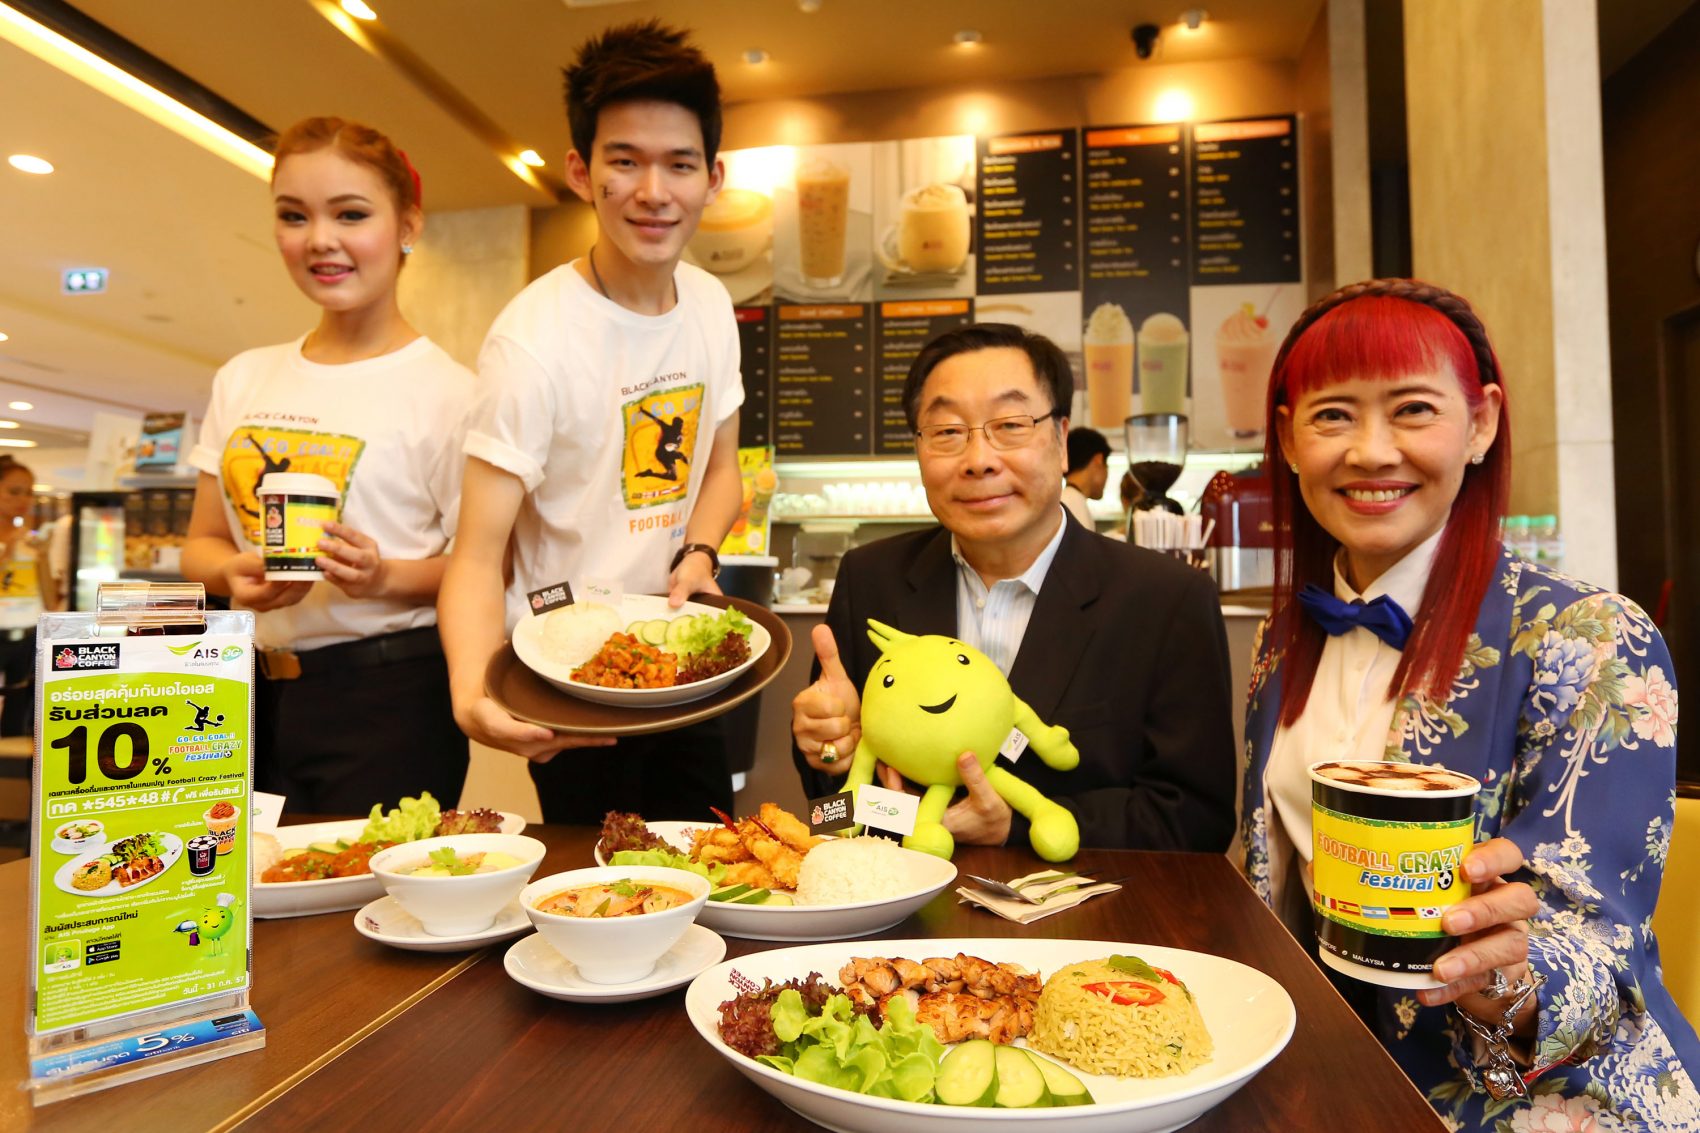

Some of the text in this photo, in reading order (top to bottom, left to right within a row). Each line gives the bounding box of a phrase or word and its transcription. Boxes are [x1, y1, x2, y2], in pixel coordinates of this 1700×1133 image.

[650, 371, 687, 385] ANYON
[78, 645, 117, 655] BLACK
[193, 648, 219, 660] AIS
[78, 652, 117, 662] CANYON
[78, 660, 117, 669] COFFEE
[49, 703, 168, 722] รับส่วนลด
[169, 740, 242, 755] FOOTBALL CRAZY
[185, 751, 225, 762] Festival
[167, 777, 196, 785] Football
[198, 775, 217, 783] Crazy
[219, 772, 245, 780] Festival
[823, 798, 846, 811] BLACK
[823, 805, 847, 817] CANYON
[824, 811, 847, 823] COFFEE
[1316, 831, 1465, 875] FOOTBALL CRAZY
[1359, 869, 1436, 893] Festival
[1352, 953, 1386, 967] MALAYSIA
